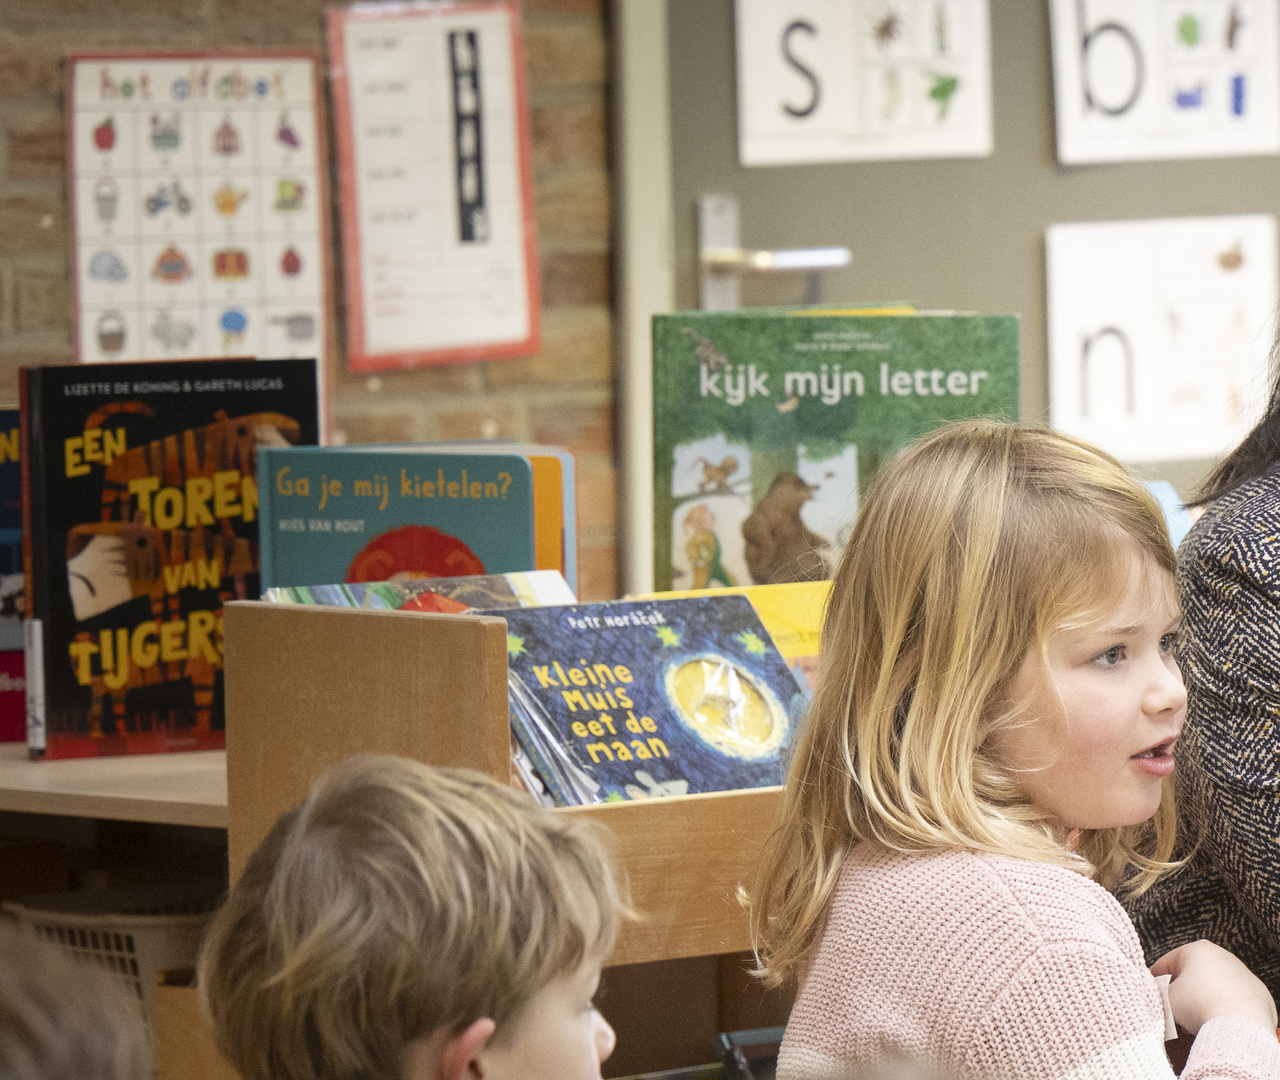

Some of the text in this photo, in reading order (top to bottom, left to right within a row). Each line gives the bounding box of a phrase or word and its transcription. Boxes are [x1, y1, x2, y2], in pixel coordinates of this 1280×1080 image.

[781, 20, 822, 118] s
[1081, 0, 1146, 118] b
[63, 377, 284, 396] LIZETTE DE KONING & GARETH LUCAS
[700, 362, 988, 406] kijk mijn letter
[1078, 326, 1136, 418] n
[64, 426, 127, 478] EEN
[276, 466, 512, 512] Ga je mij kietelen?
[308, 518, 332, 532] VAN
[163, 558, 222, 595] VAN
[532, 659, 634, 689] Kleine
[561, 684, 635, 712] Muis
[571, 710, 658, 738] eet de
[586, 736, 670, 764] maan
